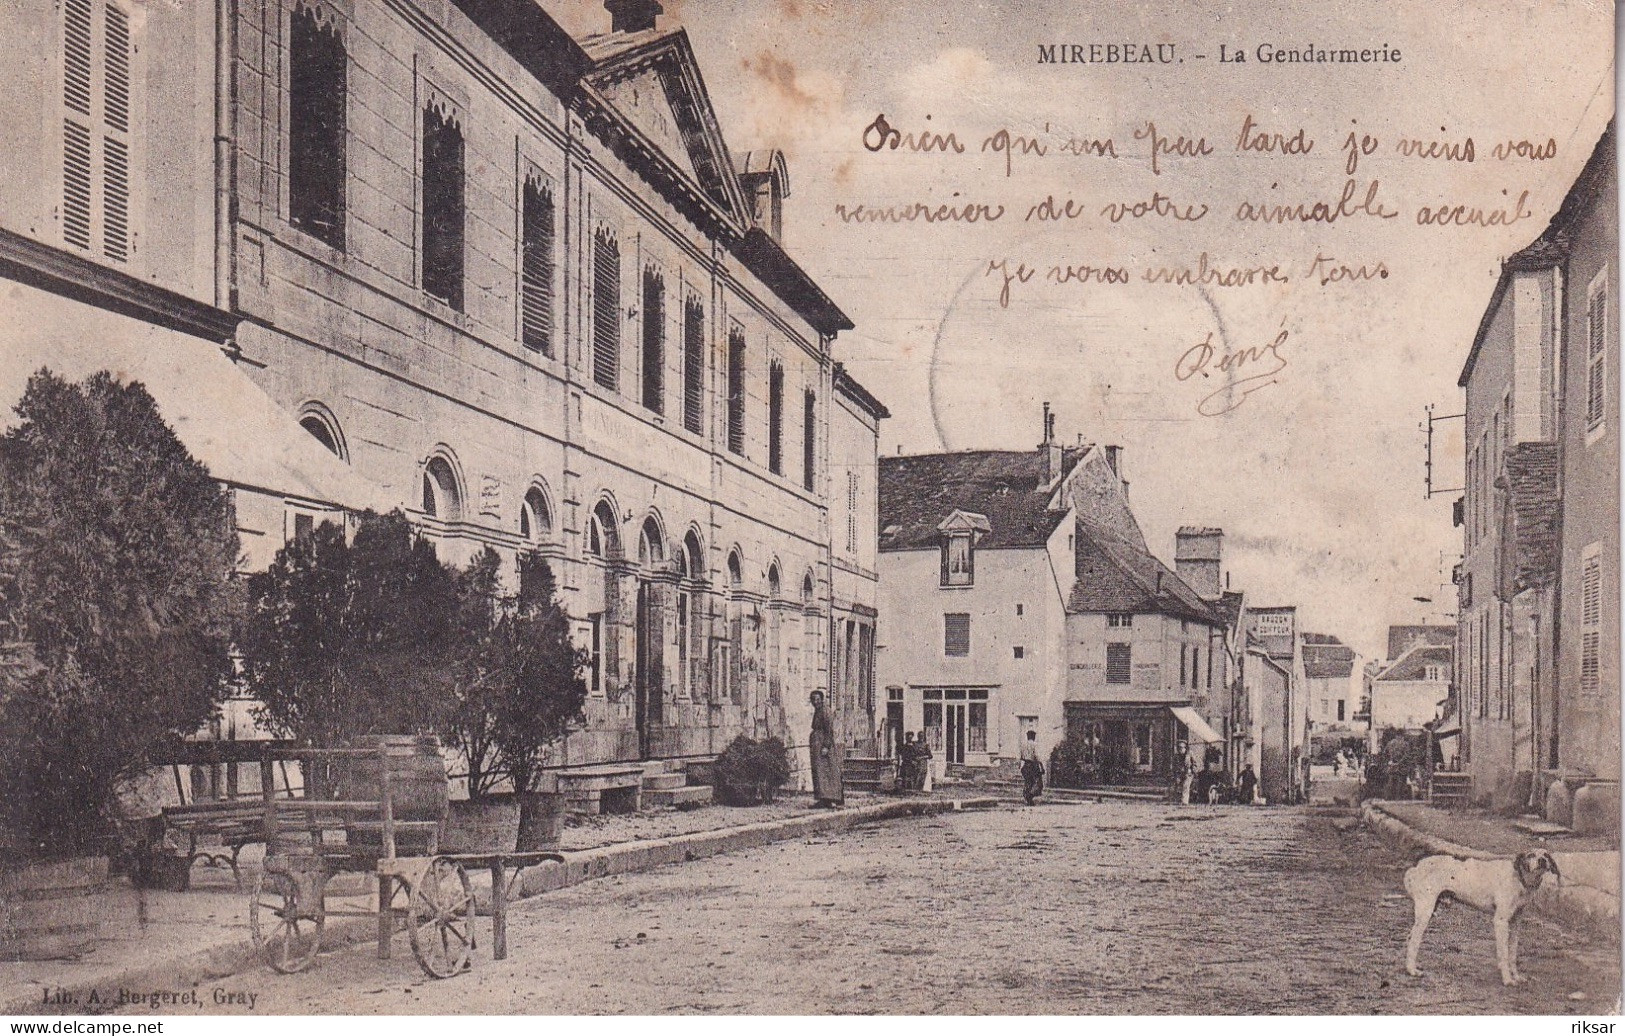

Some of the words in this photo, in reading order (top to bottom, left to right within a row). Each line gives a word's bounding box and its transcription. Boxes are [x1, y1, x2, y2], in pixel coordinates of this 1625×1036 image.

[863, 114, 965, 153] Bien
[1134, 120, 1215, 176] peu
[1236, 114, 1315, 156] tard
[1341, 118, 1379, 175] je
[1399, 126, 1475, 162] viens
[1491, 137, 1557, 161] vous
[835, 192, 1005, 223] remercier
[1025, 195, 1084, 222] de
[1101, 192, 1209, 222] votre
[1236, 179, 1398, 224] aimable
[1416, 189, 1532, 227] accueil
